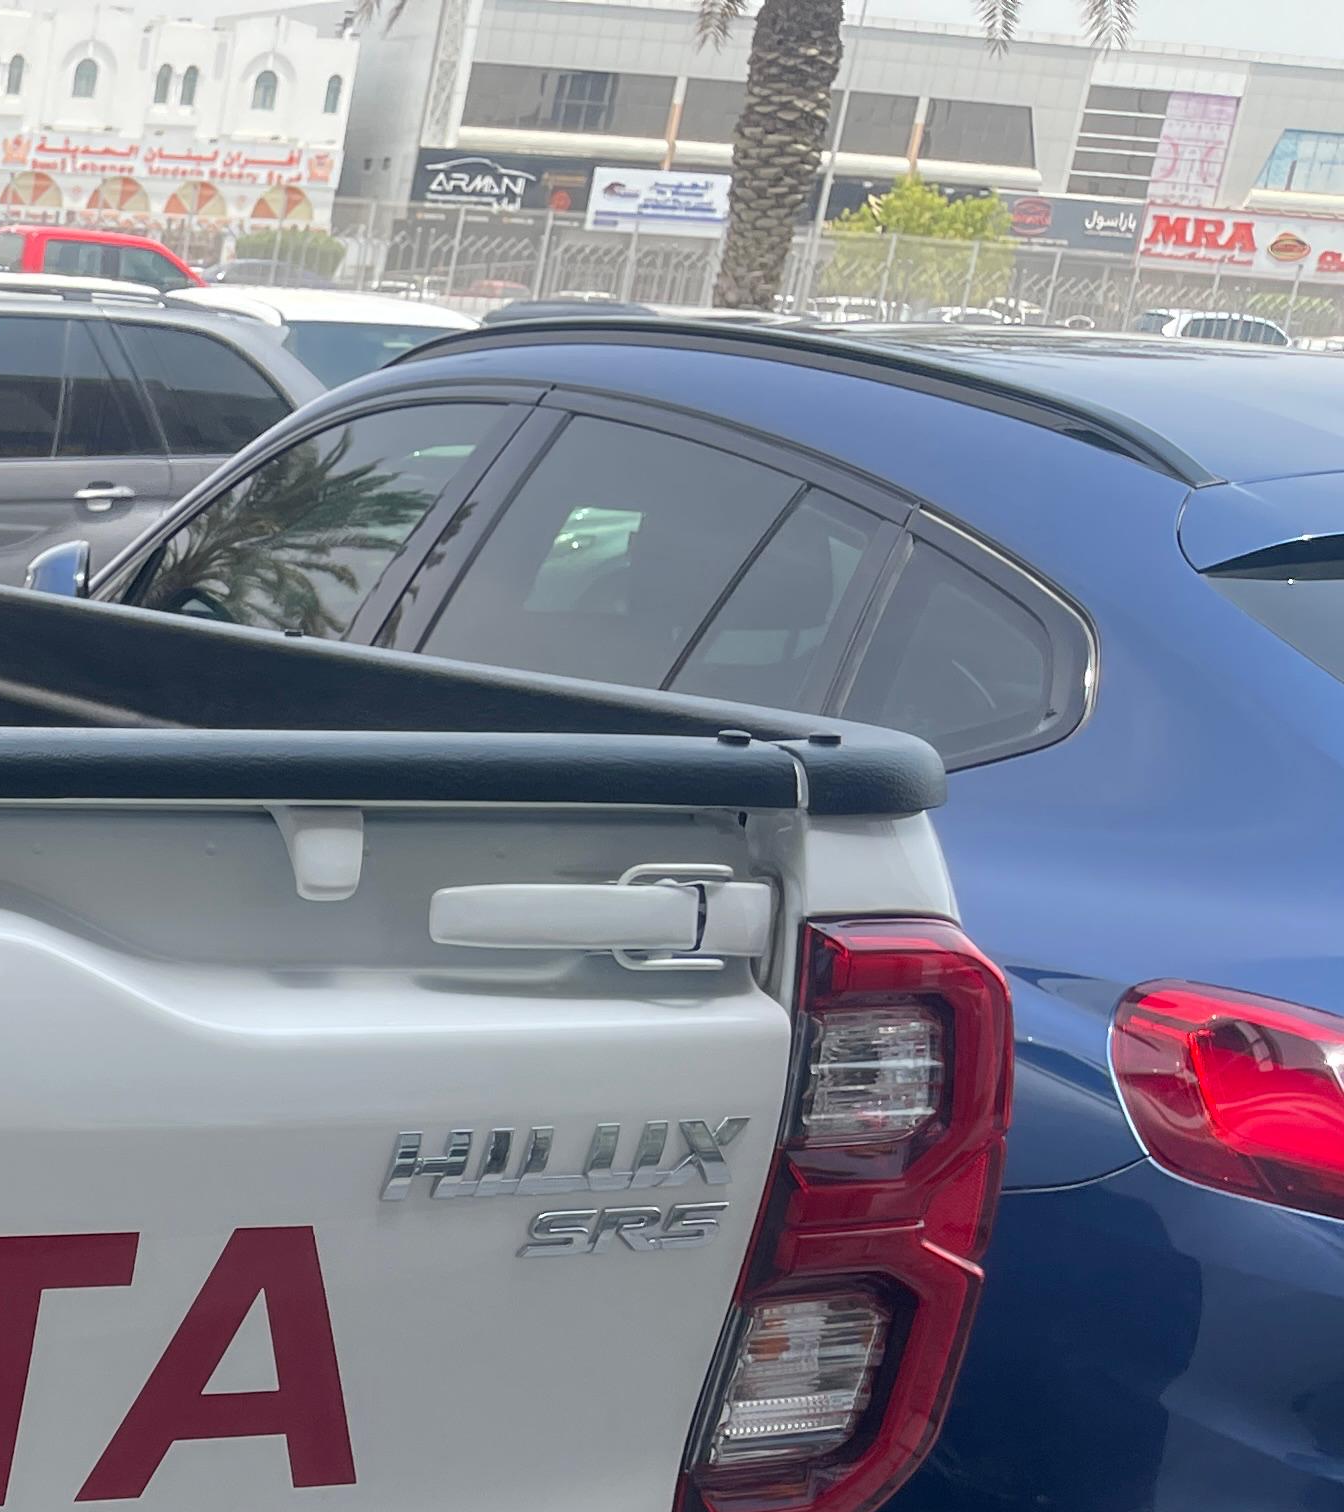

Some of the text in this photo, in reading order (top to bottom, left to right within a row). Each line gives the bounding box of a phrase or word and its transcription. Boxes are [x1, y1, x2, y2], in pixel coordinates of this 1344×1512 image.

[1144, 214, 1258, 252] MRA
[380, 1116, 751, 1201] HILUX
[515, 1202, 730, 1258] SR5
